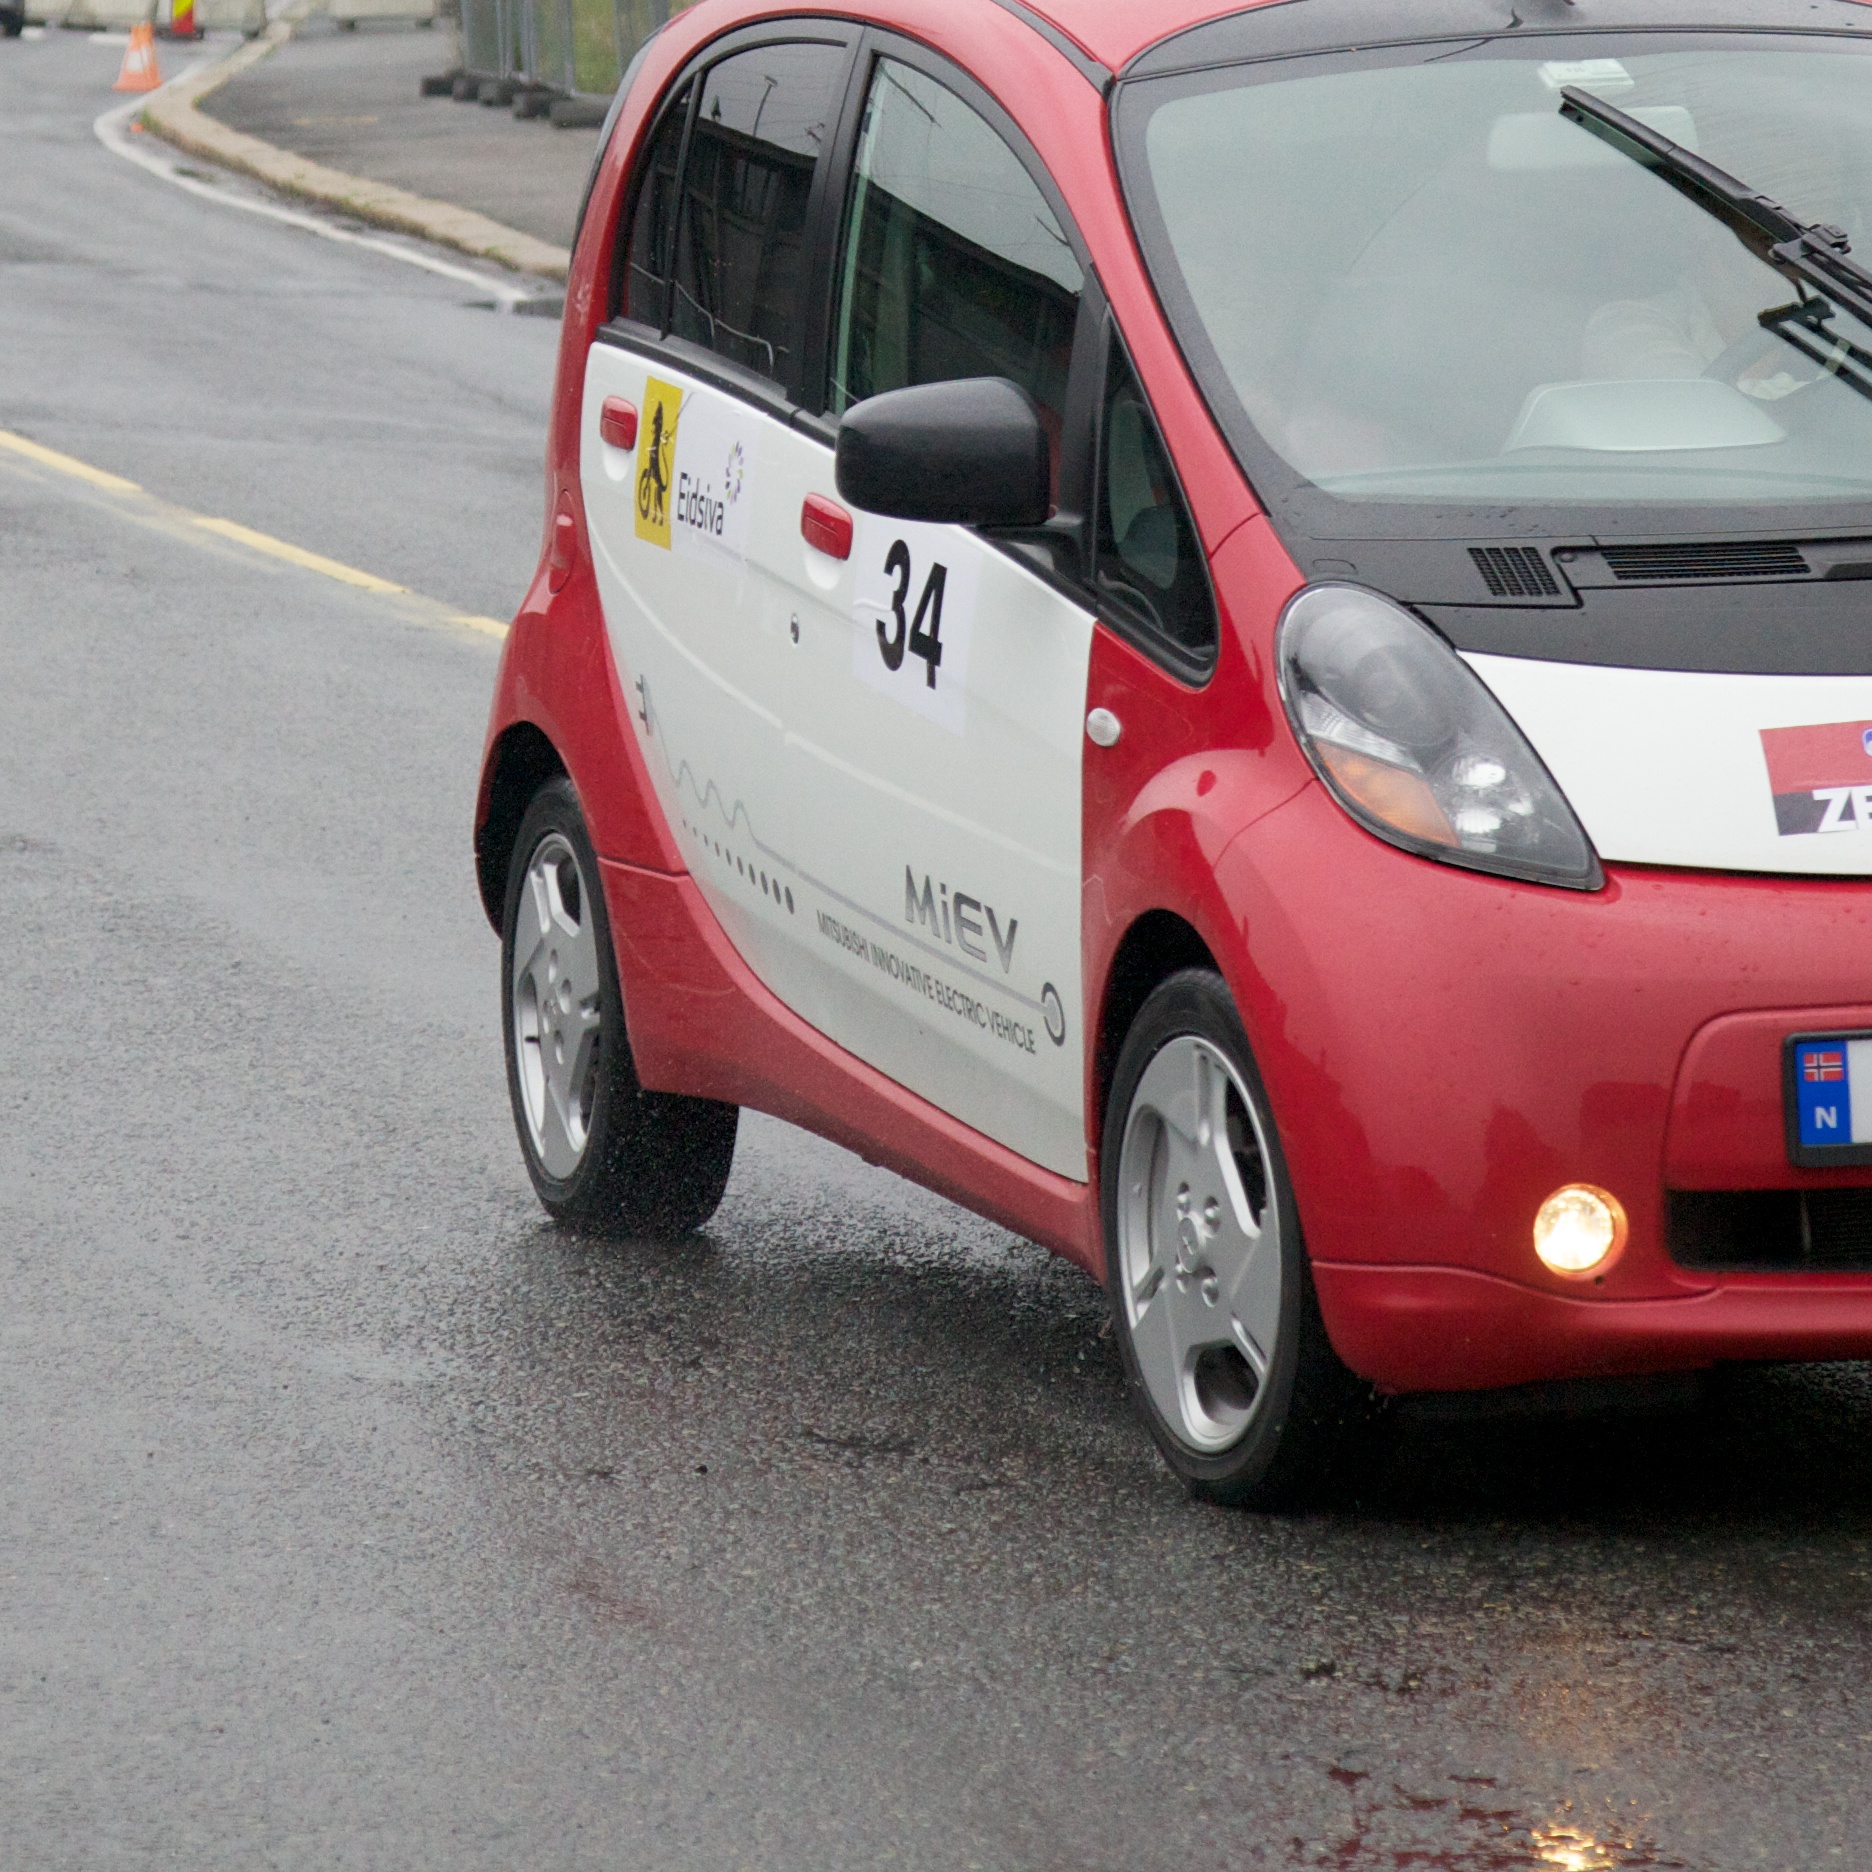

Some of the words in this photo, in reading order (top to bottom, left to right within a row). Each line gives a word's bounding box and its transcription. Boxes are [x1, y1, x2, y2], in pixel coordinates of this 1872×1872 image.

[677, 469, 725, 536] Eidsiva
[875, 538, 949, 690] 34
[904, 863, 1018, 975] MiEV
[816, 908, 871, 964] MITSUBISHI
[870, 941, 935, 1001] INNOVATIVE
[935, 978, 988, 1029] ELECTRIC
[985, 1005, 1037, 1056] VEHICLE
[1814, 1106, 1838, 1129] N
